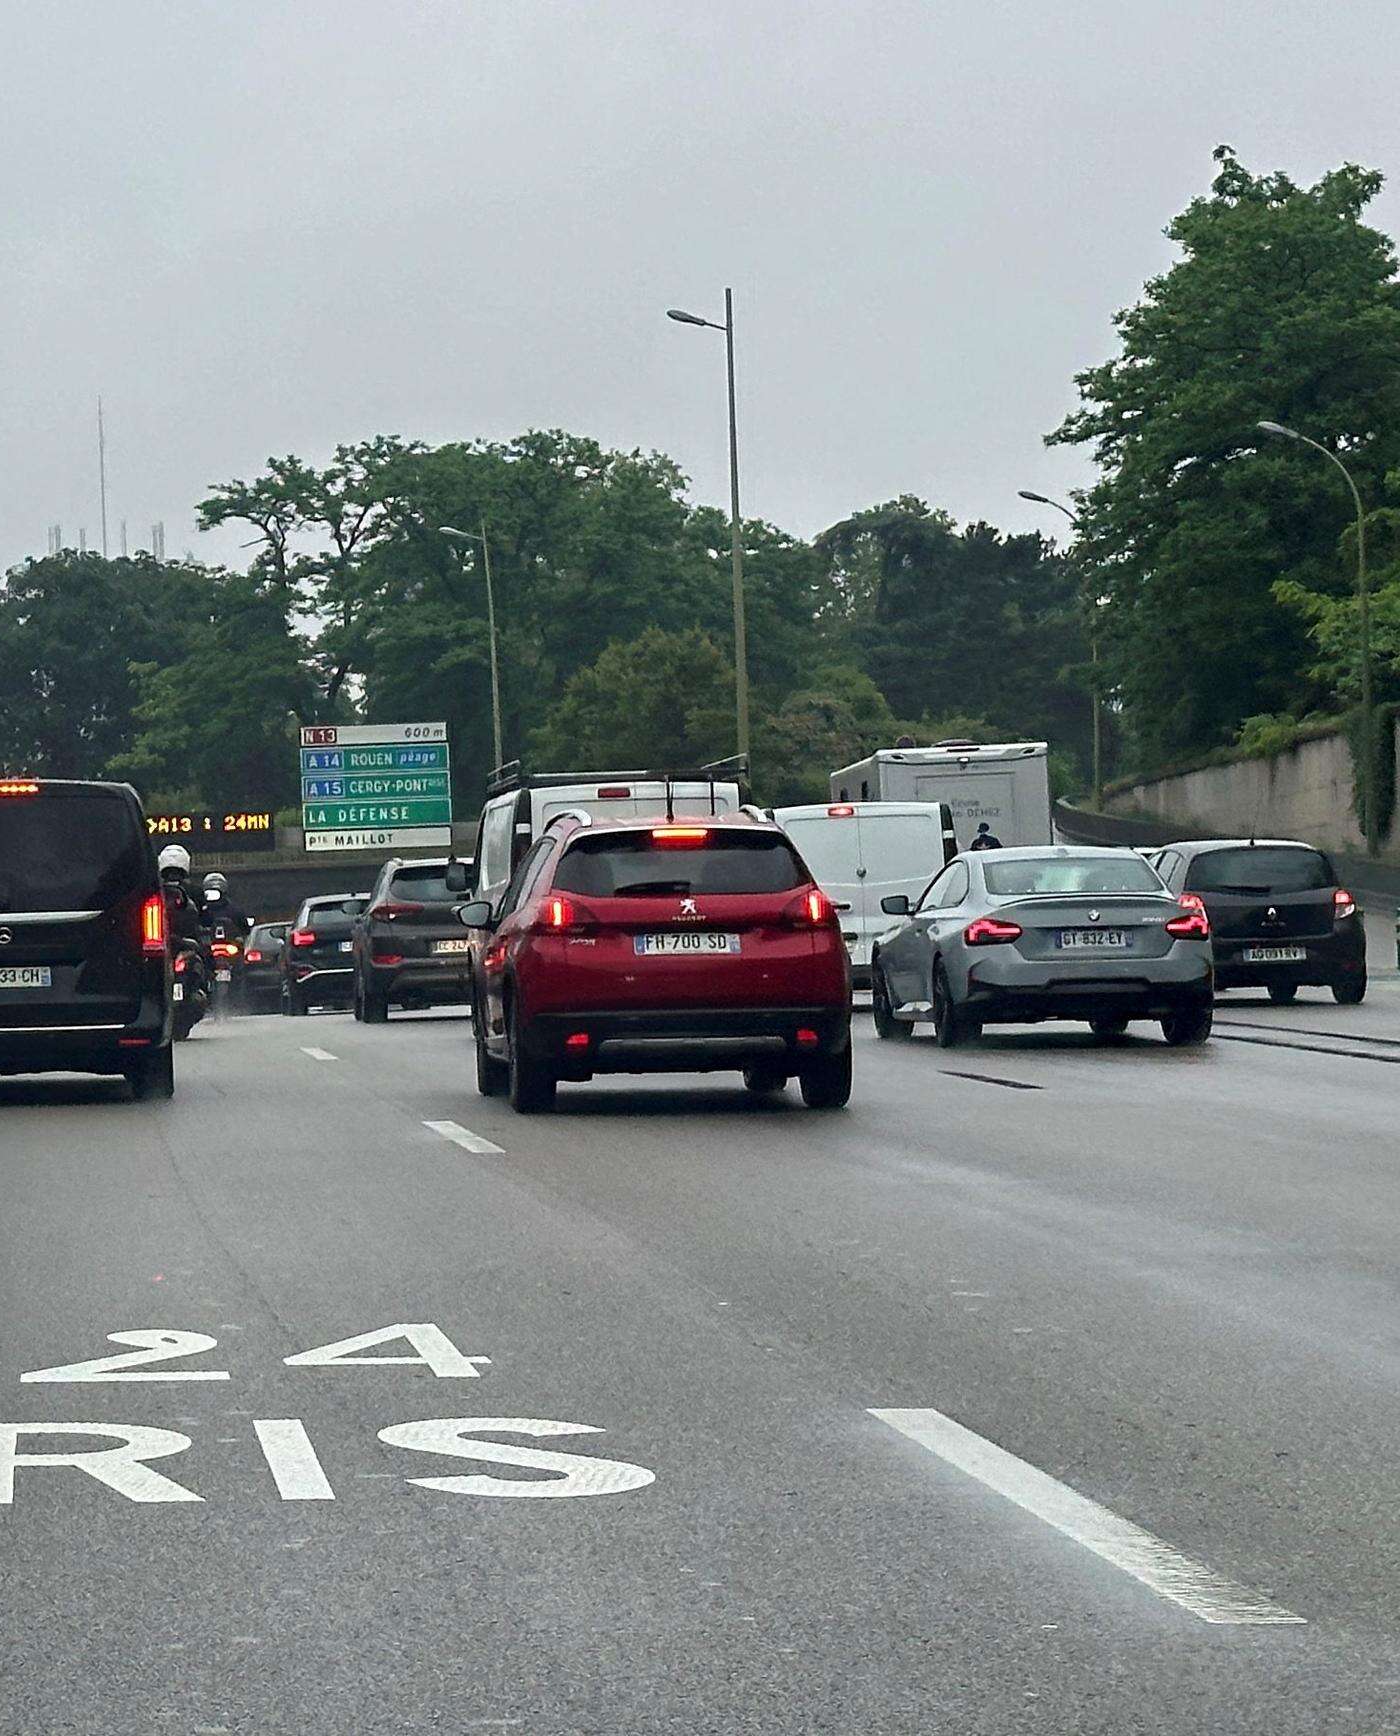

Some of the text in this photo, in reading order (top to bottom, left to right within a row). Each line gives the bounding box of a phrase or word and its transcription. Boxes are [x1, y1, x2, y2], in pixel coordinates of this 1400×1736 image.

[305, 727, 444, 743] N 13 600 m
[309, 750, 436, 768] A 14 ROUEN péage
[309, 783, 318, 796] A
[324, 781, 342, 795] 15
[223, 813, 270, 831] 24MN
[309, 810, 326, 823] LA
[335, 833, 394, 846] MAILLOT
